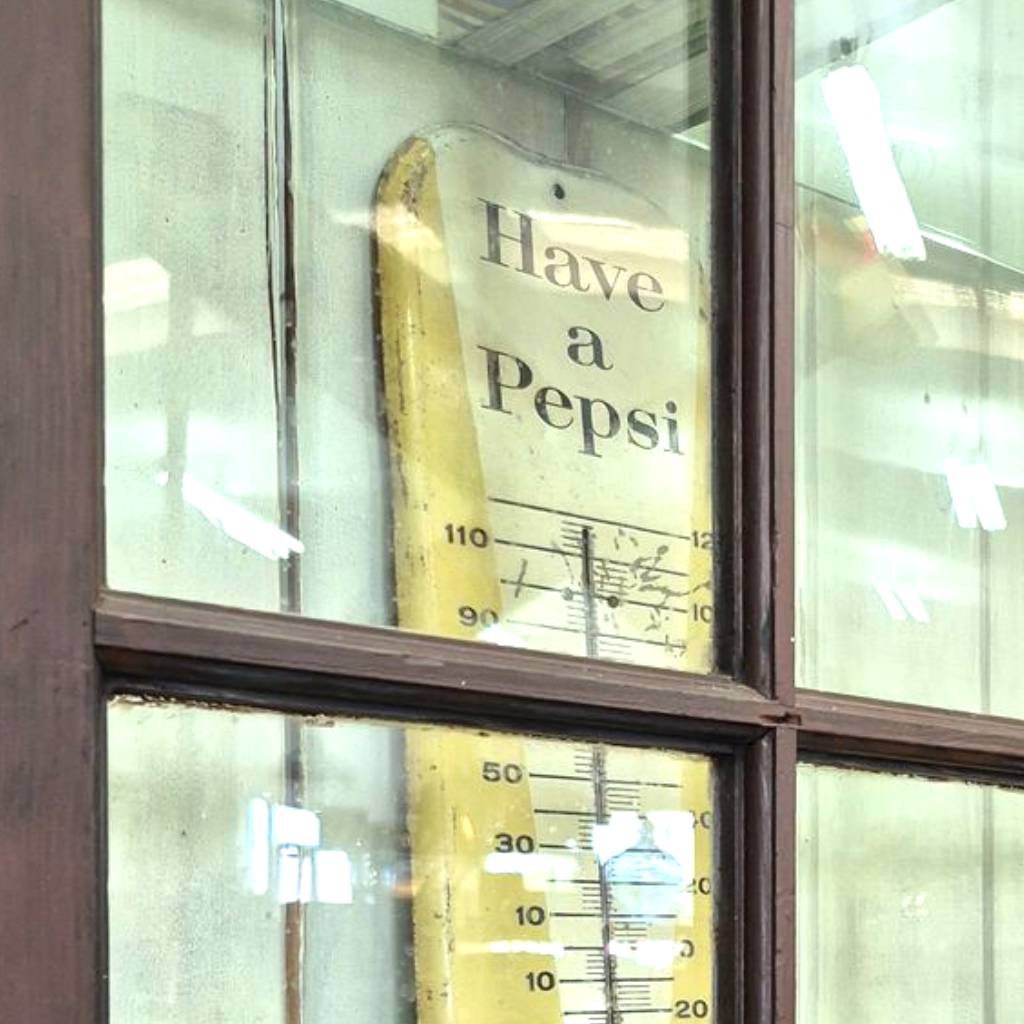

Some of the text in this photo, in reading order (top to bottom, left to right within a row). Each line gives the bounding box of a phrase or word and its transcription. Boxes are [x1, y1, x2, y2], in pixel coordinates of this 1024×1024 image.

[476, 197, 665, 312] Have
[567, 325, 613, 371] a
[476, 344, 686, 458] Pepsi
[445, 523, 713, 549] 110 12
[458, 603, 712, 627] 90 10
[482, 762, 523, 783] 50
[494, 834, 534, 853] 30
[516, 906, 545, 925] 10
[525, 972, 556, 991] 10
[674, 1000, 709, 1018] 20
